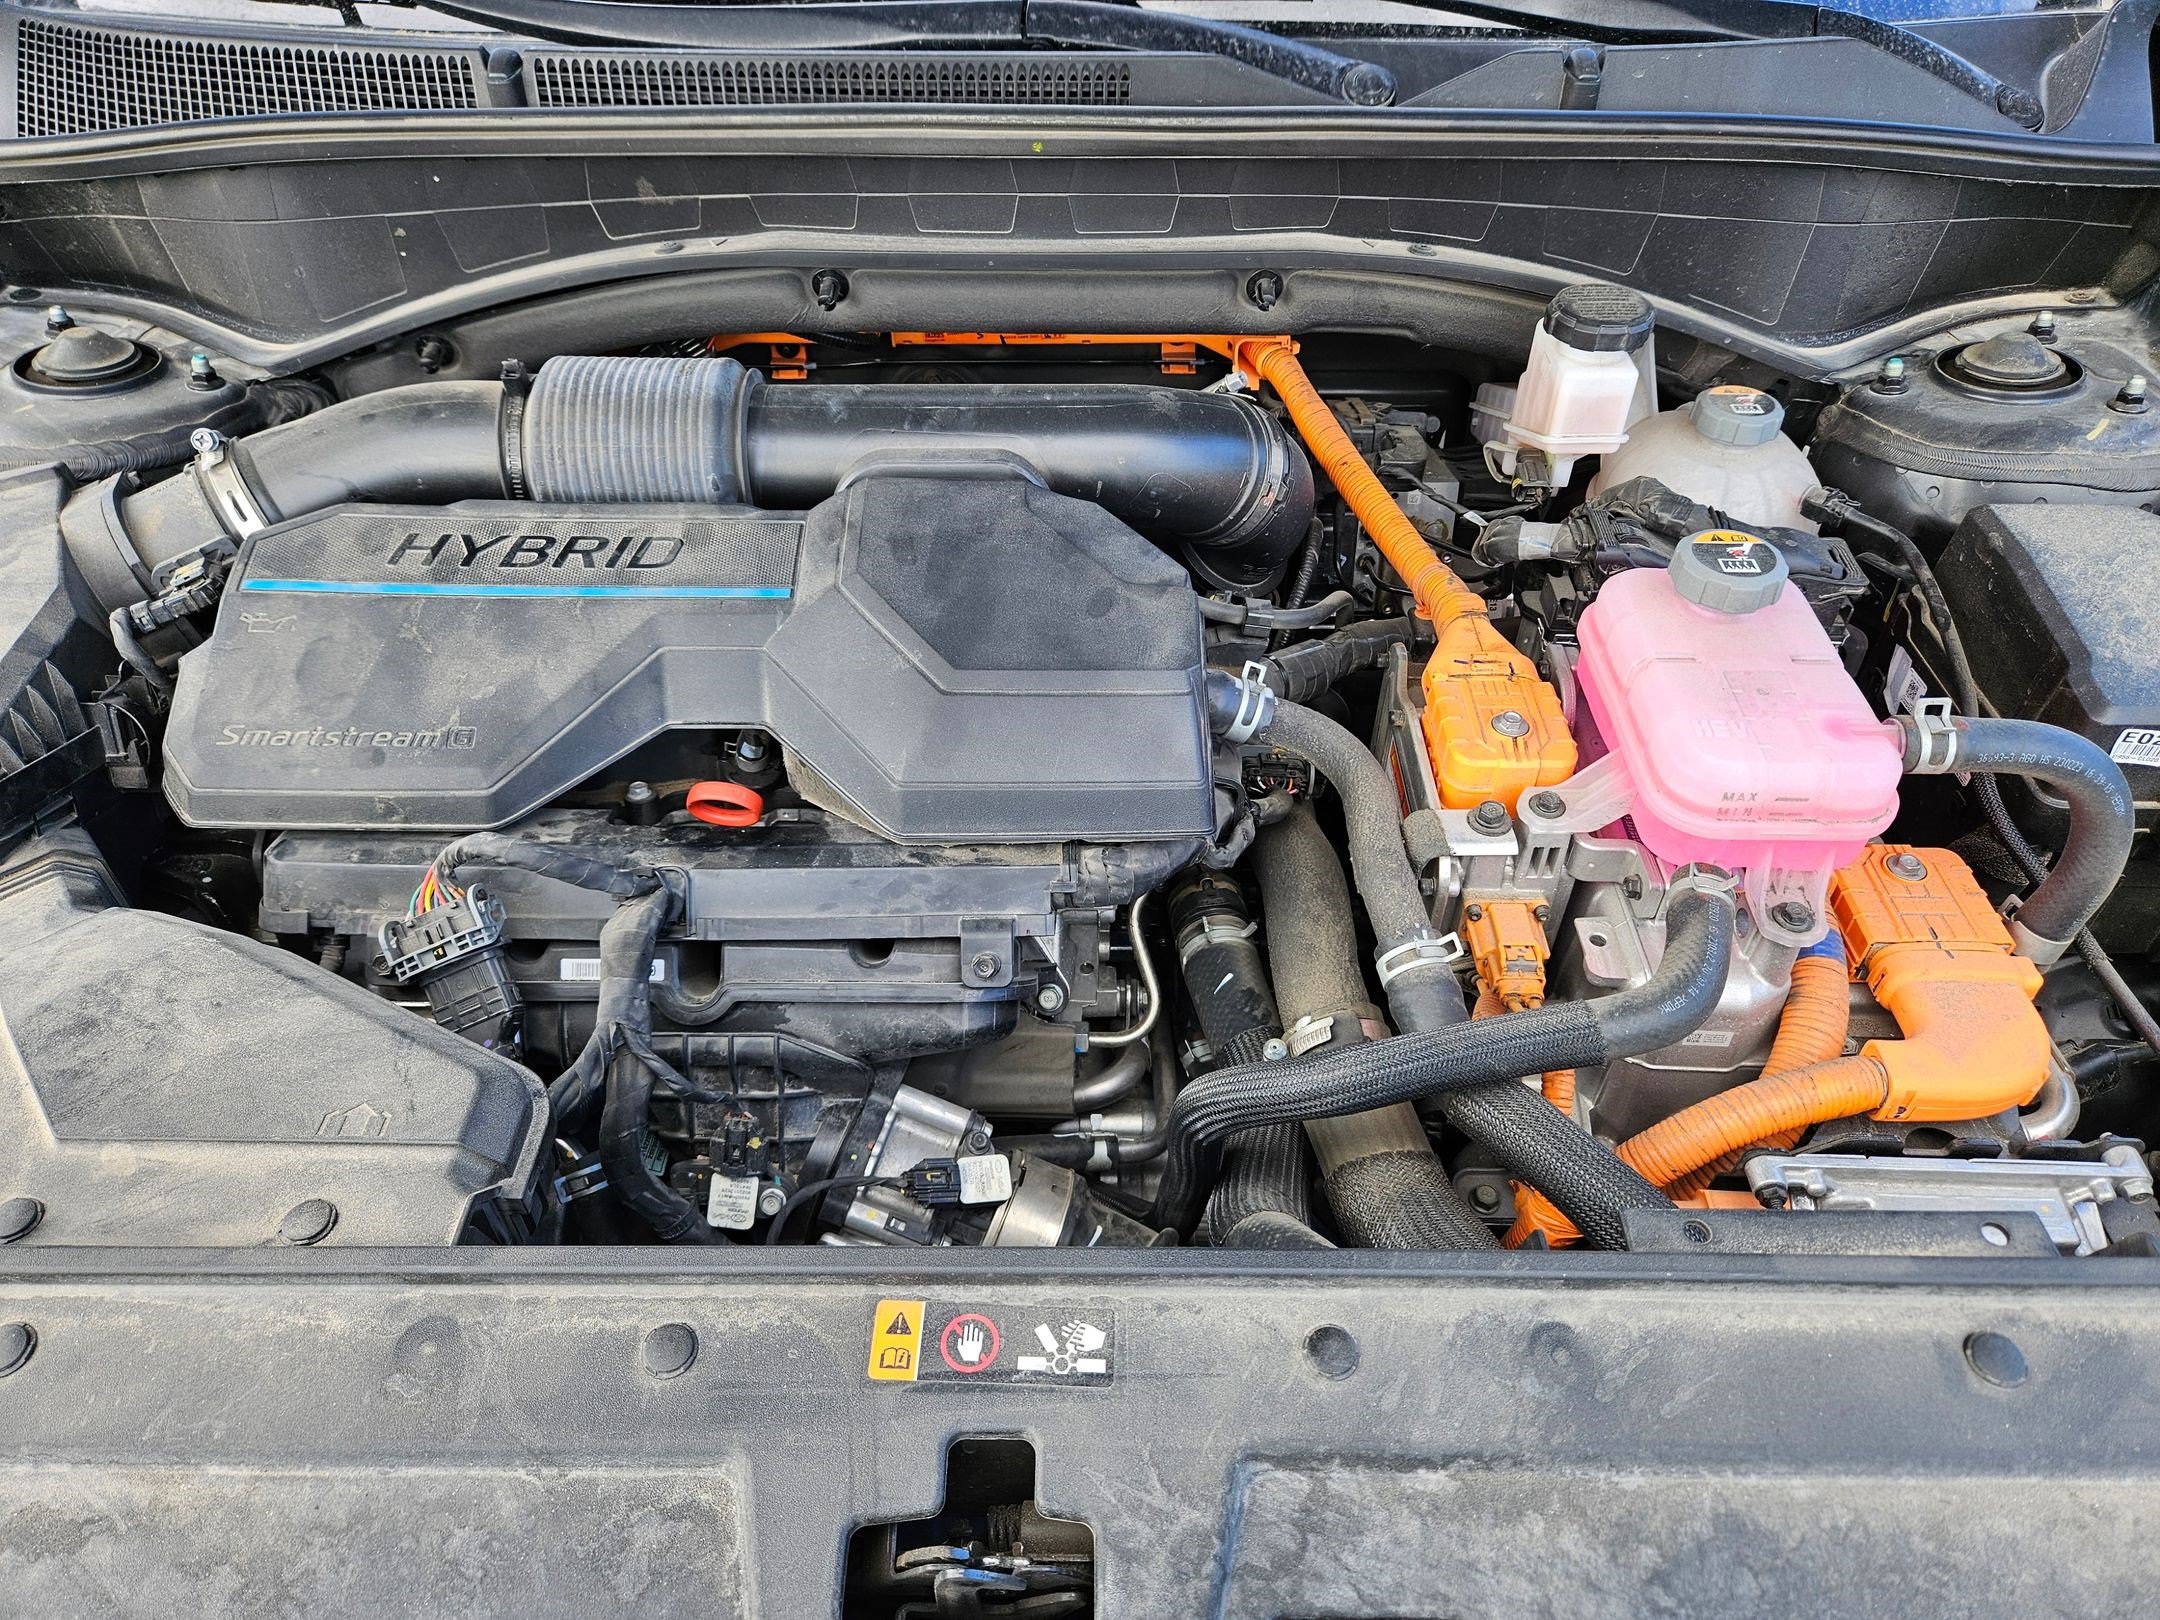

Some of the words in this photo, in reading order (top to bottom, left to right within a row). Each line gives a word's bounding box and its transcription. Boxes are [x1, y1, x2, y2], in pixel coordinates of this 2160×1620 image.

[386, 532, 684, 569] HYBRID
[215, 724, 441, 748] Smartstream
[449, 726, 477, 749] G
[1692, 719, 1750, 738] HEV
[2053, 756, 2084, 773] 230223
[1721, 792, 1759, 802] MAX
[1716, 807, 1753, 816] MIN
